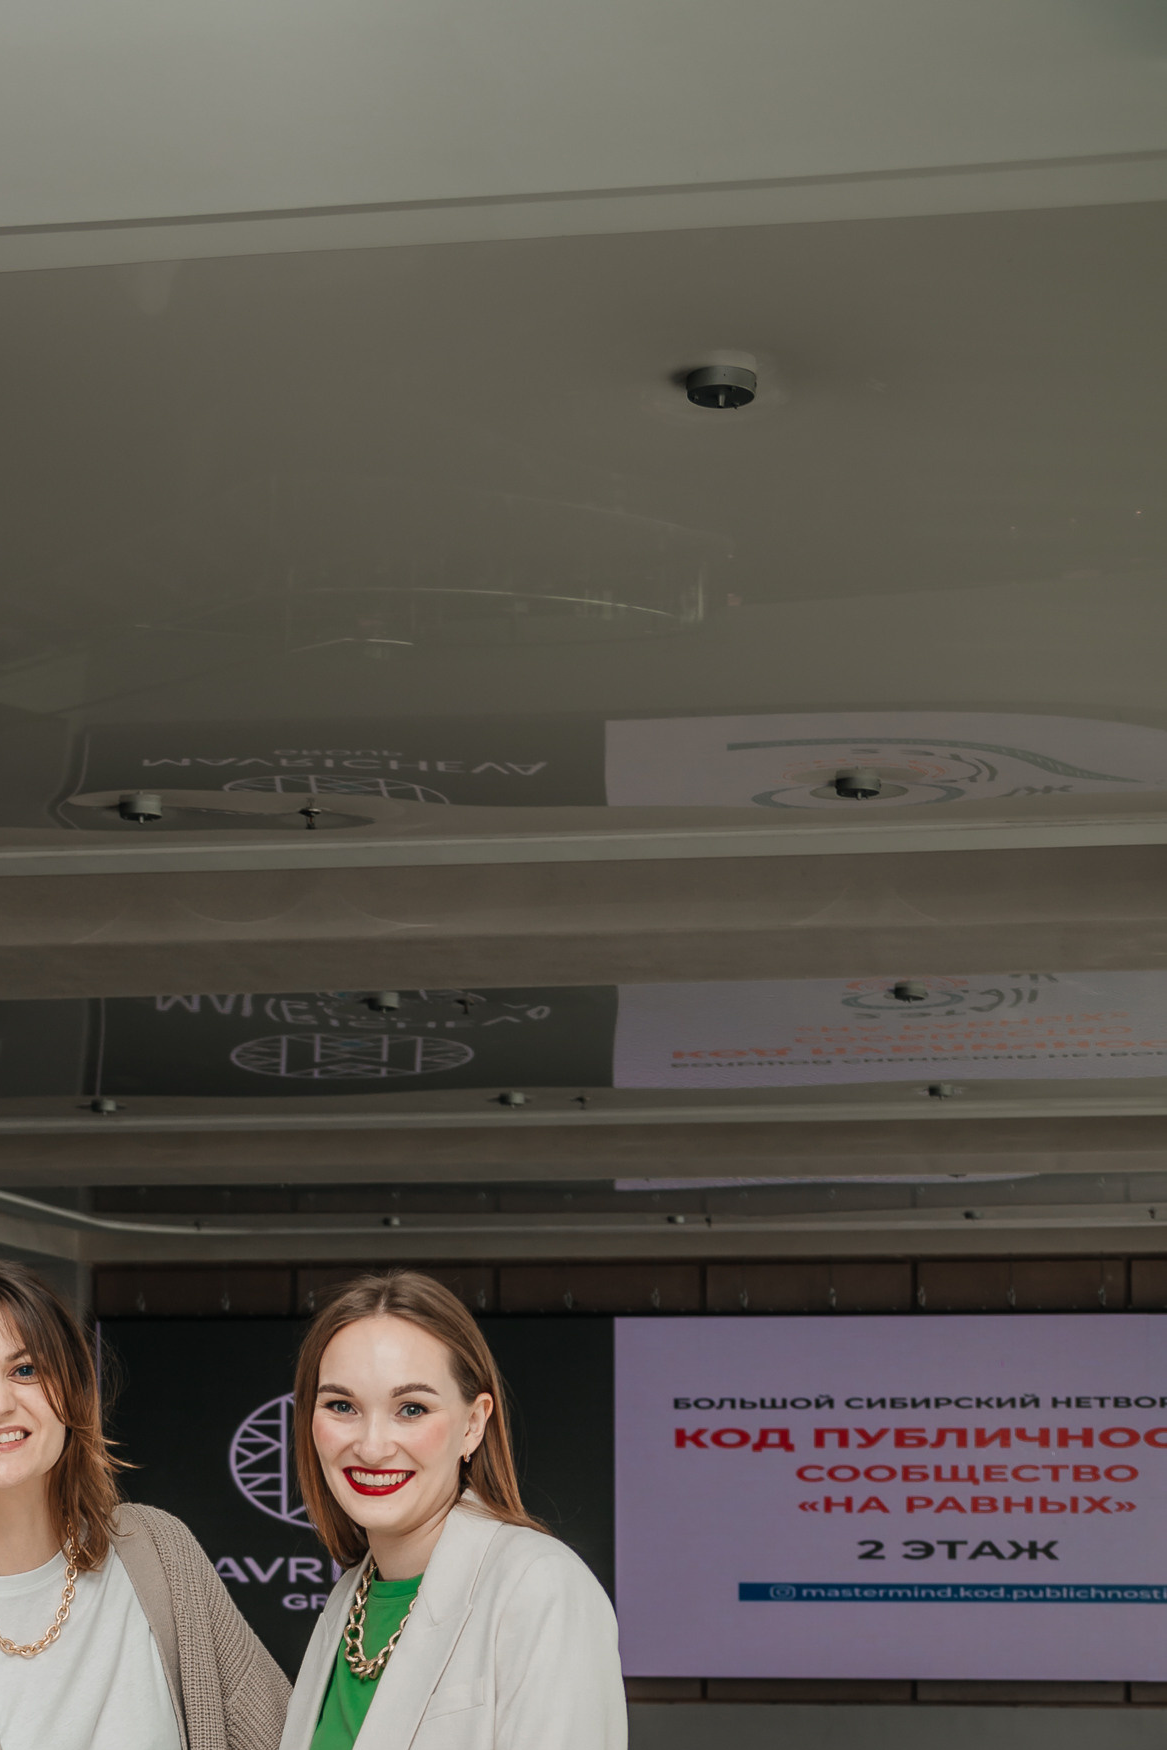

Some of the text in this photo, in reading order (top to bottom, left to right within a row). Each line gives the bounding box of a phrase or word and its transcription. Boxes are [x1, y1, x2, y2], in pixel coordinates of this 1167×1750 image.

[673, 1394, 835, 1410] БОЛЬШОЙ
[844, 1394, 1040, 1410] СИБИРСКИЙ
[675, 1427, 795, 1452] КОД
[796, 1465, 1139, 1485] СООБЩЕСТВО
[798, 1496, 1137, 1514] «НА РАВНЫХ»
[857, 1540, 1059, 1560] 2 ЭТАЖ
